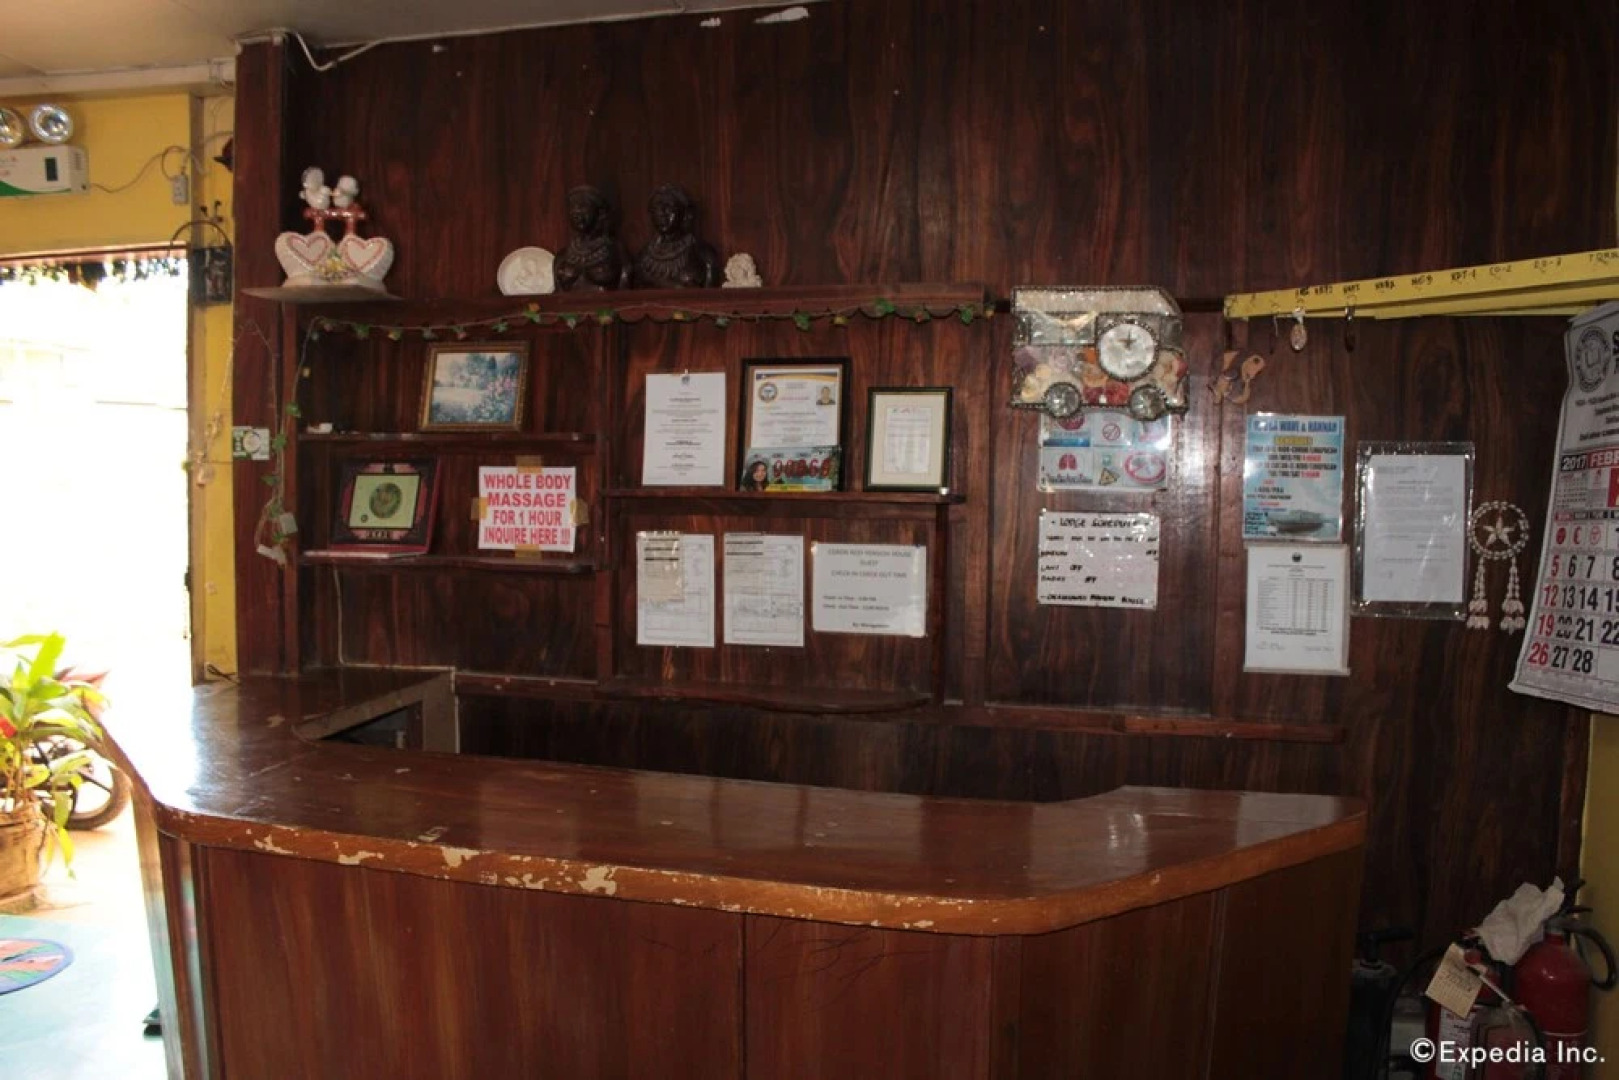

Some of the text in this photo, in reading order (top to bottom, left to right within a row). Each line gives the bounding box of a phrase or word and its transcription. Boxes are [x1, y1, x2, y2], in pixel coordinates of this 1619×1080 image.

[1561, 455, 1587, 471] 2017
[484, 474, 571, 489] WHOLE BODY
[488, 492, 566, 507] MASSAGE
[493, 510, 562, 525] FOR 1 HOUR
[484, 528, 527, 544] INQUIRE
[531, 529, 557, 544] HERE
[1551, 555, 1560, 577] 5
[1568, 555, 1578, 578] 6
[1586, 556, 1596, 578] 7
[1544, 585, 1558, 607] 12
[1562, 586, 1575, 609] 13
[1579, 587, 1598, 611] 14
[1538, 615, 1554, 638] 19
[1575, 617, 1594, 641] 21
[1529, 643, 1594, 673] 26 27 28
